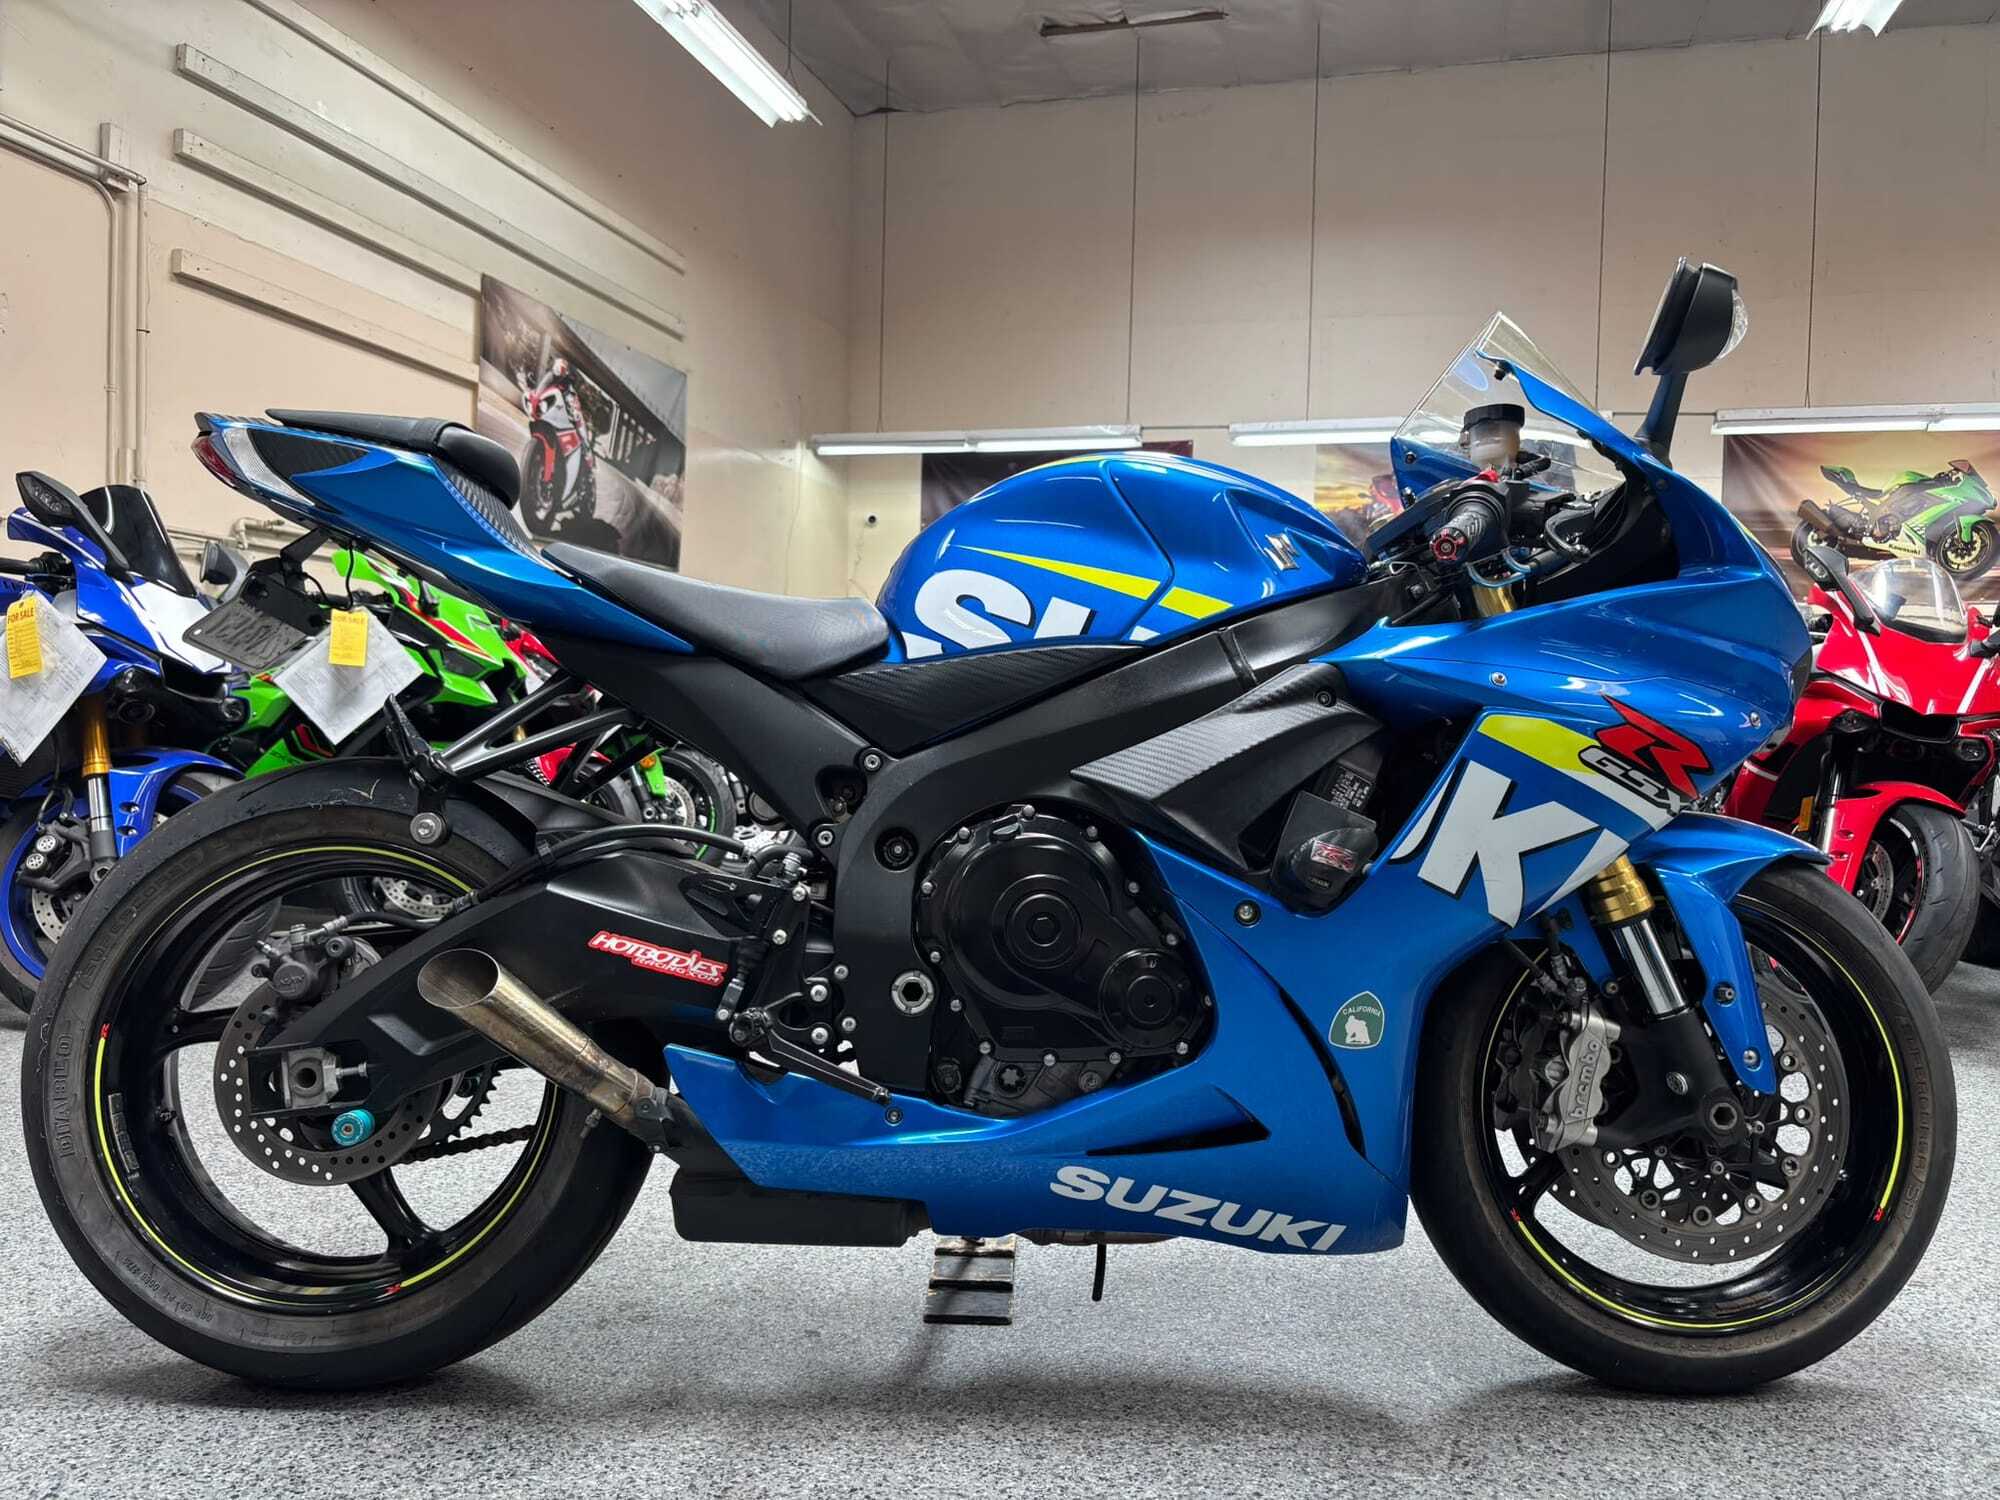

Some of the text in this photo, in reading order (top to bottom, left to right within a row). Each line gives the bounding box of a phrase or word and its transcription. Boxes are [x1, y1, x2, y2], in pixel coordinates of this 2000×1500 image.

[7, 607, 34, 624] FOR SALE
[591, 934, 723, 977] HOTBODIES
[1569, 1039, 1601, 1118] brembo
[1049, 1165, 1347, 1251] SUZUKI
